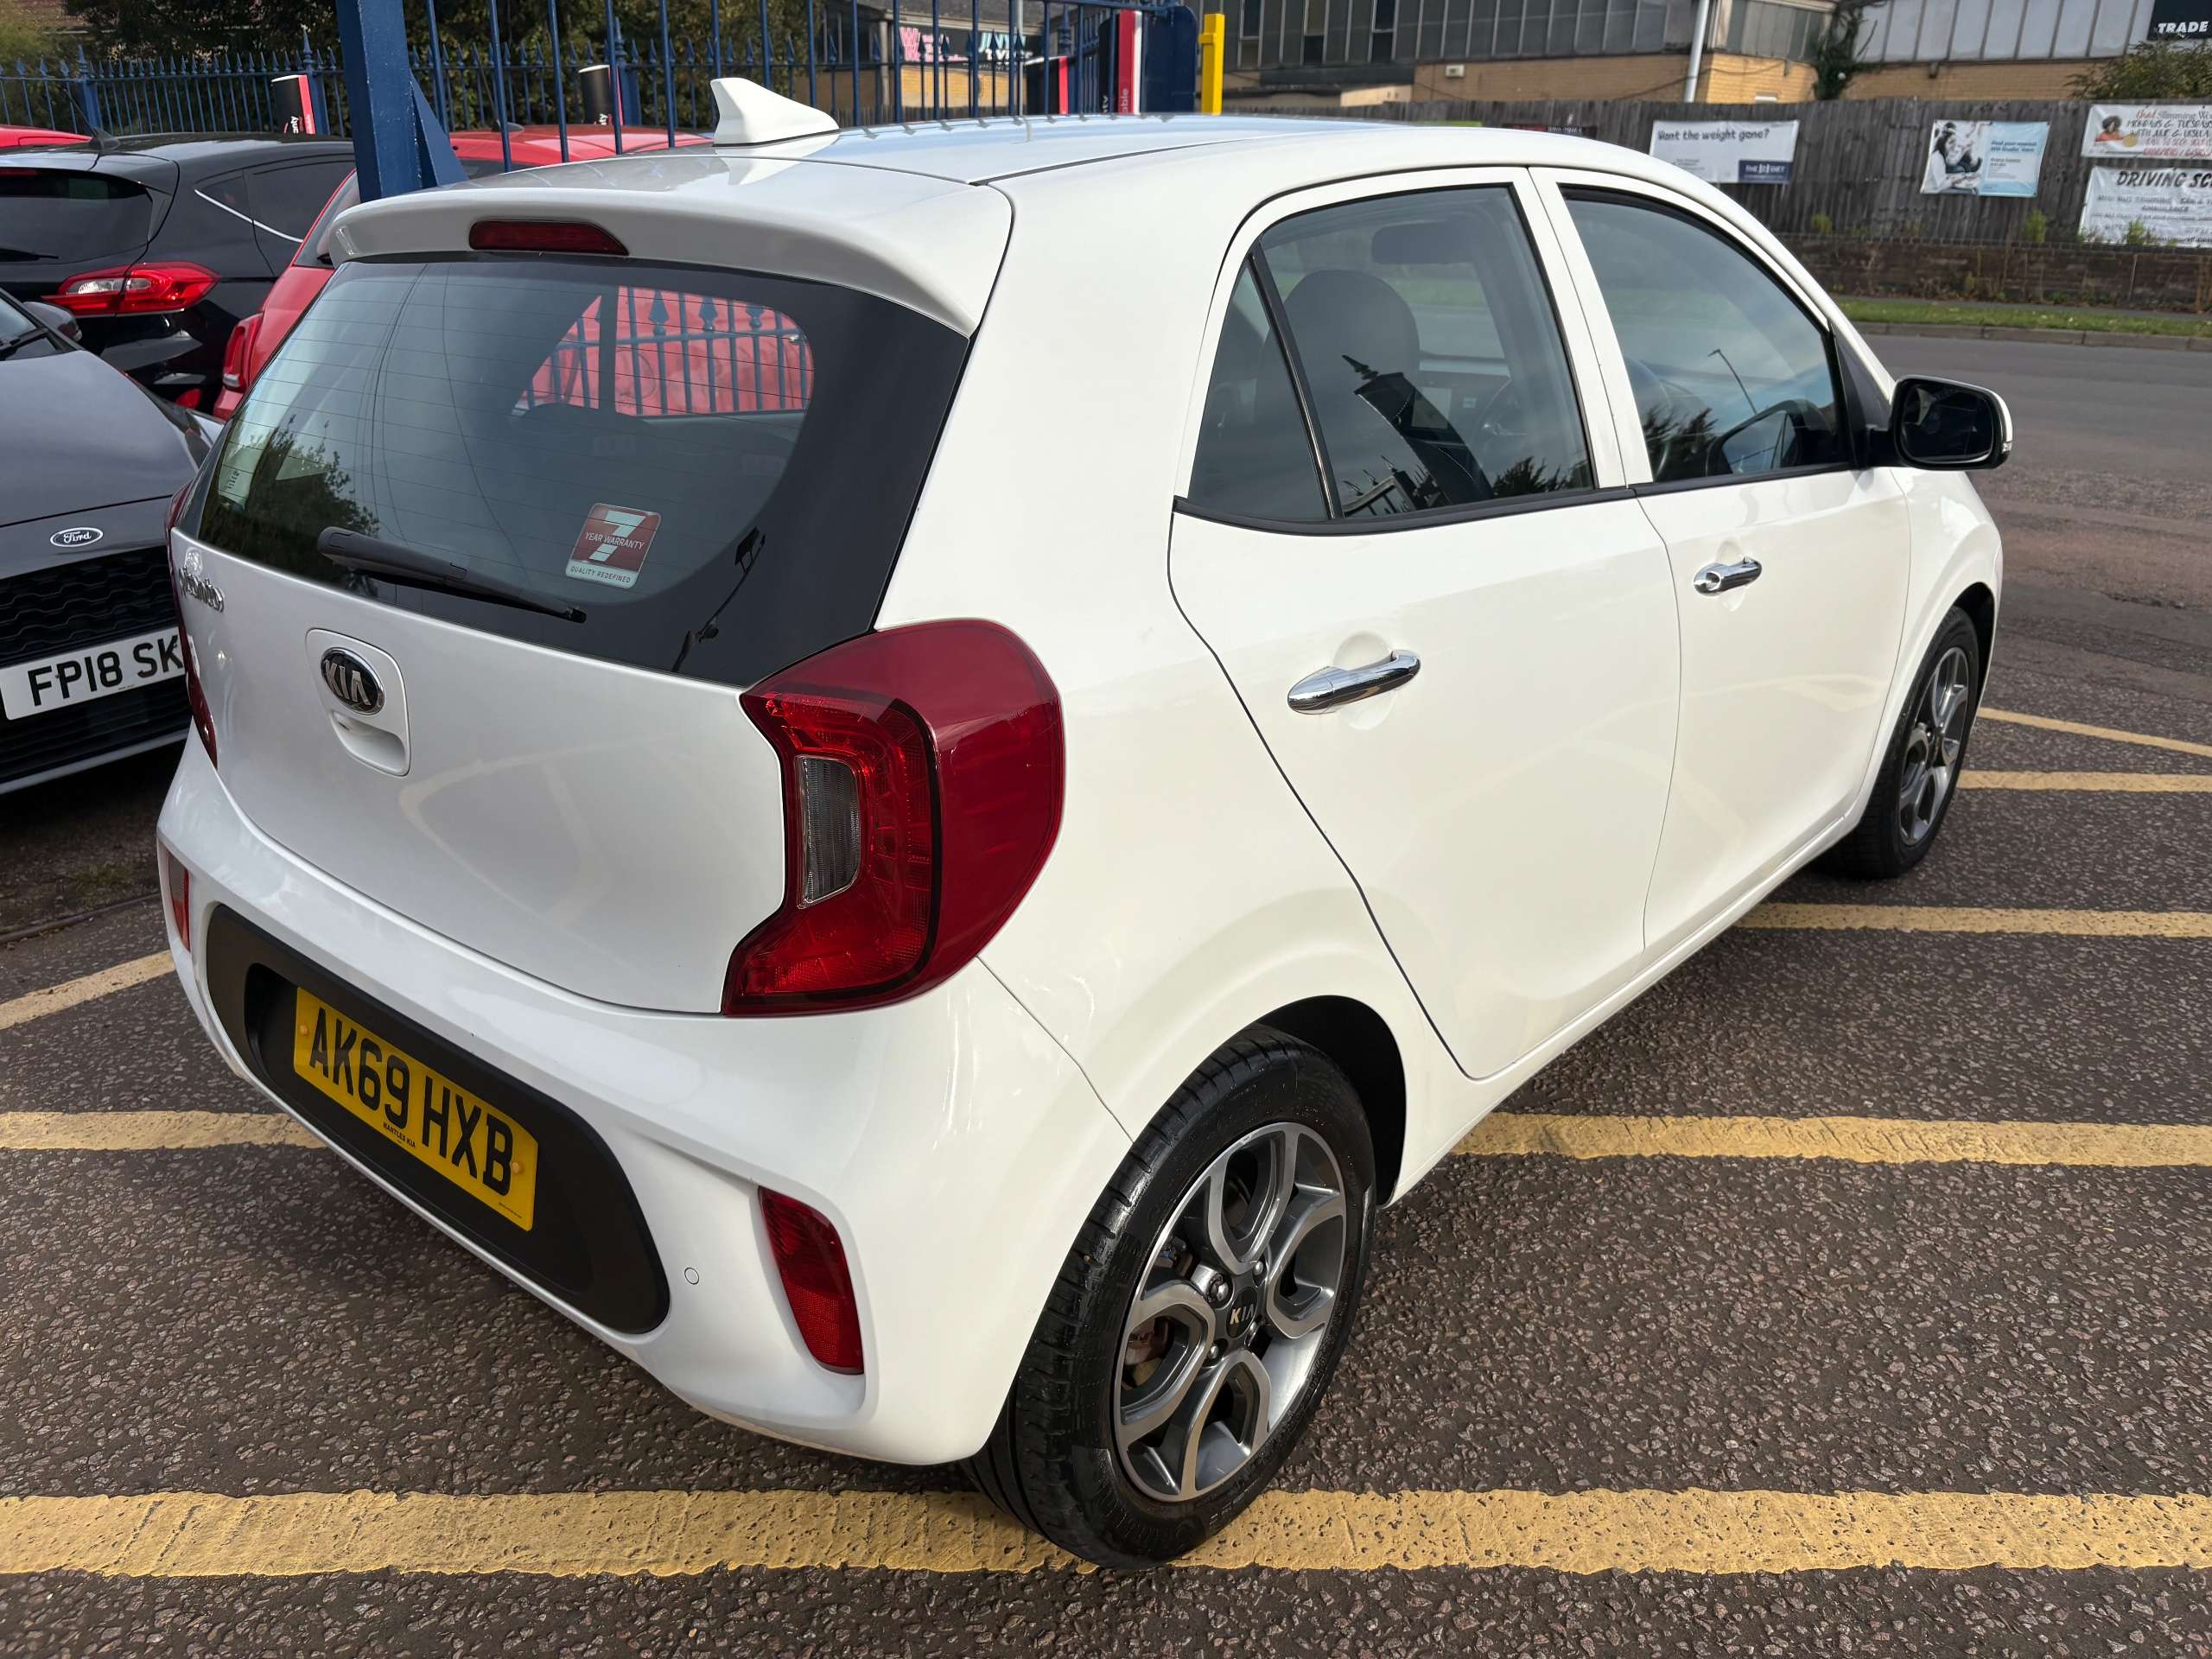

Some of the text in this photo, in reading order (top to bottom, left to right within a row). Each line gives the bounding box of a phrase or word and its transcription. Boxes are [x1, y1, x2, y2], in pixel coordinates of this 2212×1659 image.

[2158, 21, 2209, 35] TRADE
[1658, 130, 1680, 140] Want
[1682, 130, 1700, 140] the
[1702, 129, 1736, 142] weight
[2116, 171, 2212, 188] DRIVING SC
[63, 531, 92, 543] Ford
[585, 532, 645, 550] YEAR WARRANTY
[597, 572, 631, 583] REDEFINED
[28, 652, 123, 706] FP18
[323, 659, 372, 706] KIA
[309, 1007, 514, 1197] AK69 HXB
[1230, 1304, 1254, 1325] KIA
